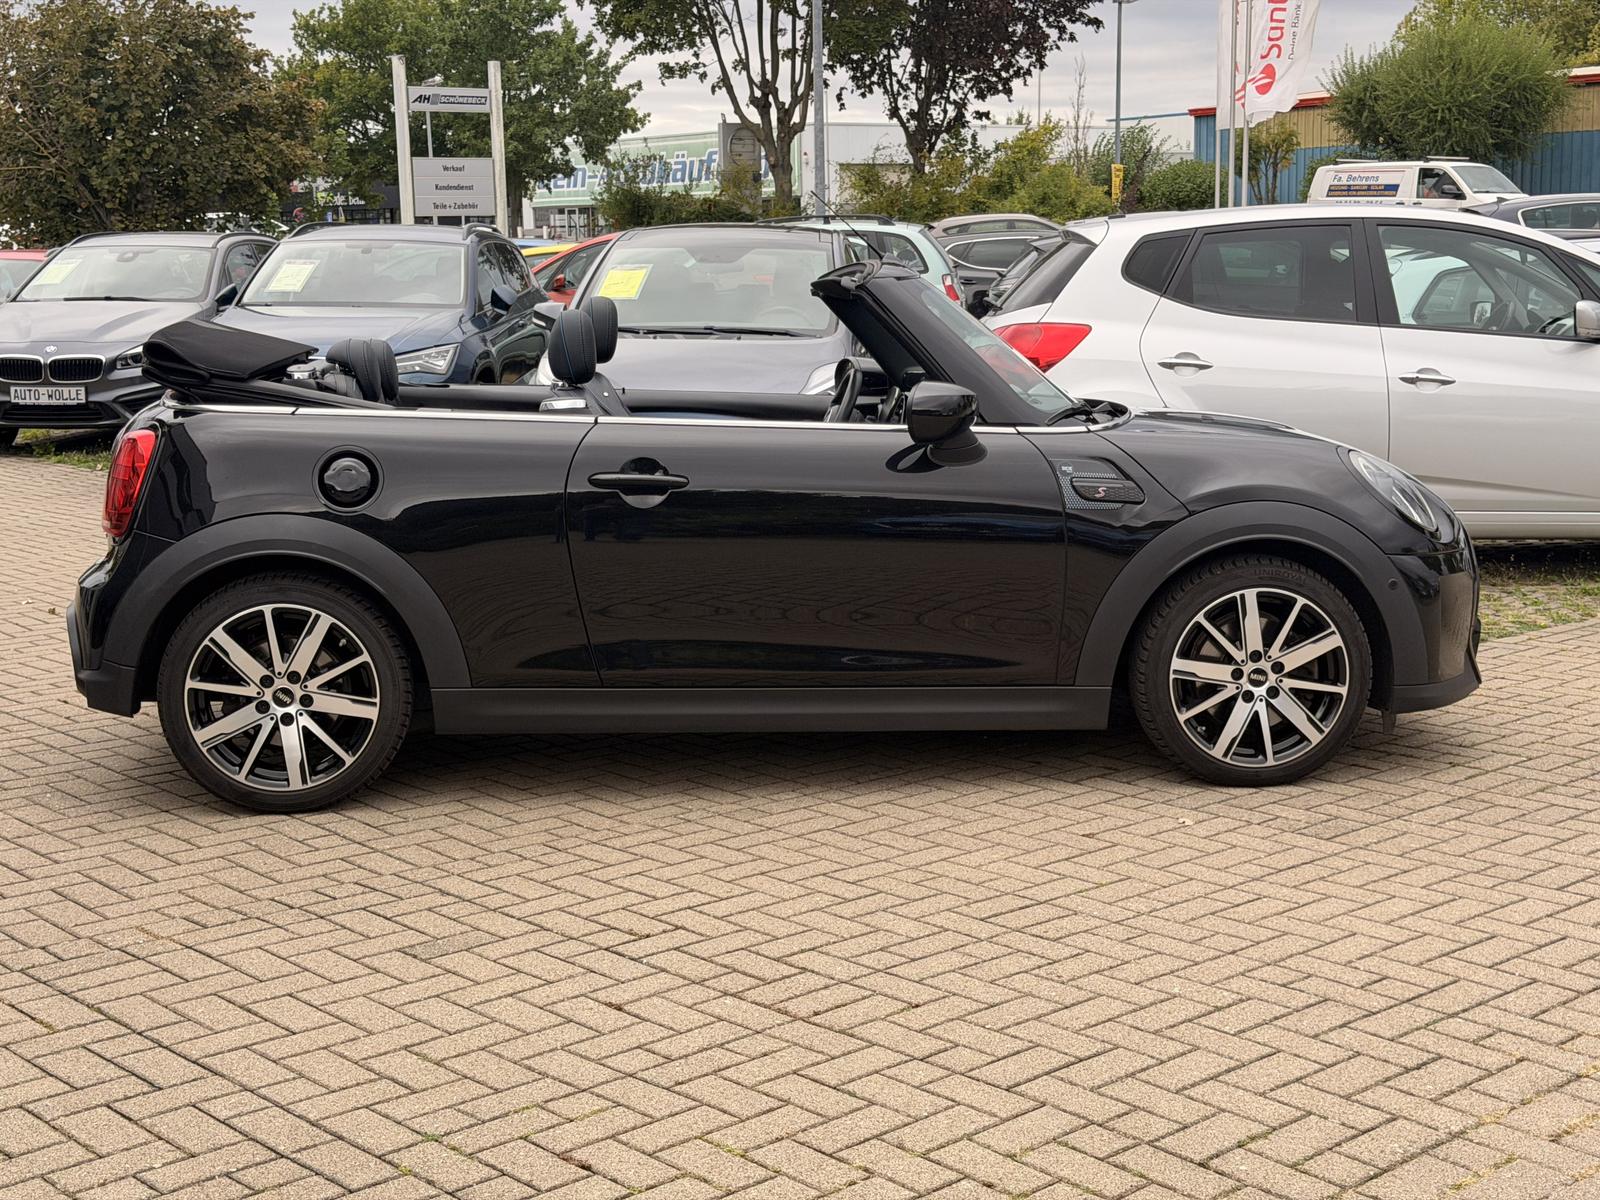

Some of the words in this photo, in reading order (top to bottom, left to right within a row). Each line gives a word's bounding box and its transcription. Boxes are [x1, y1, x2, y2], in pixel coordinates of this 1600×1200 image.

[411, 94, 431, 104] AH
[440, 95, 487, 105] SCHÖNEBECK
[442, 164, 465, 172] Verkauf
[1345, 174, 1380, 183] Behrens
[434, 183, 474, 191] Kundendienst
[432, 202, 447, 210] Teile
[453, 202, 479, 210] Zubehör
[13, 388, 84, 401] AUTO-WOLLE
[1250, 672, 1267, 682] MINI
